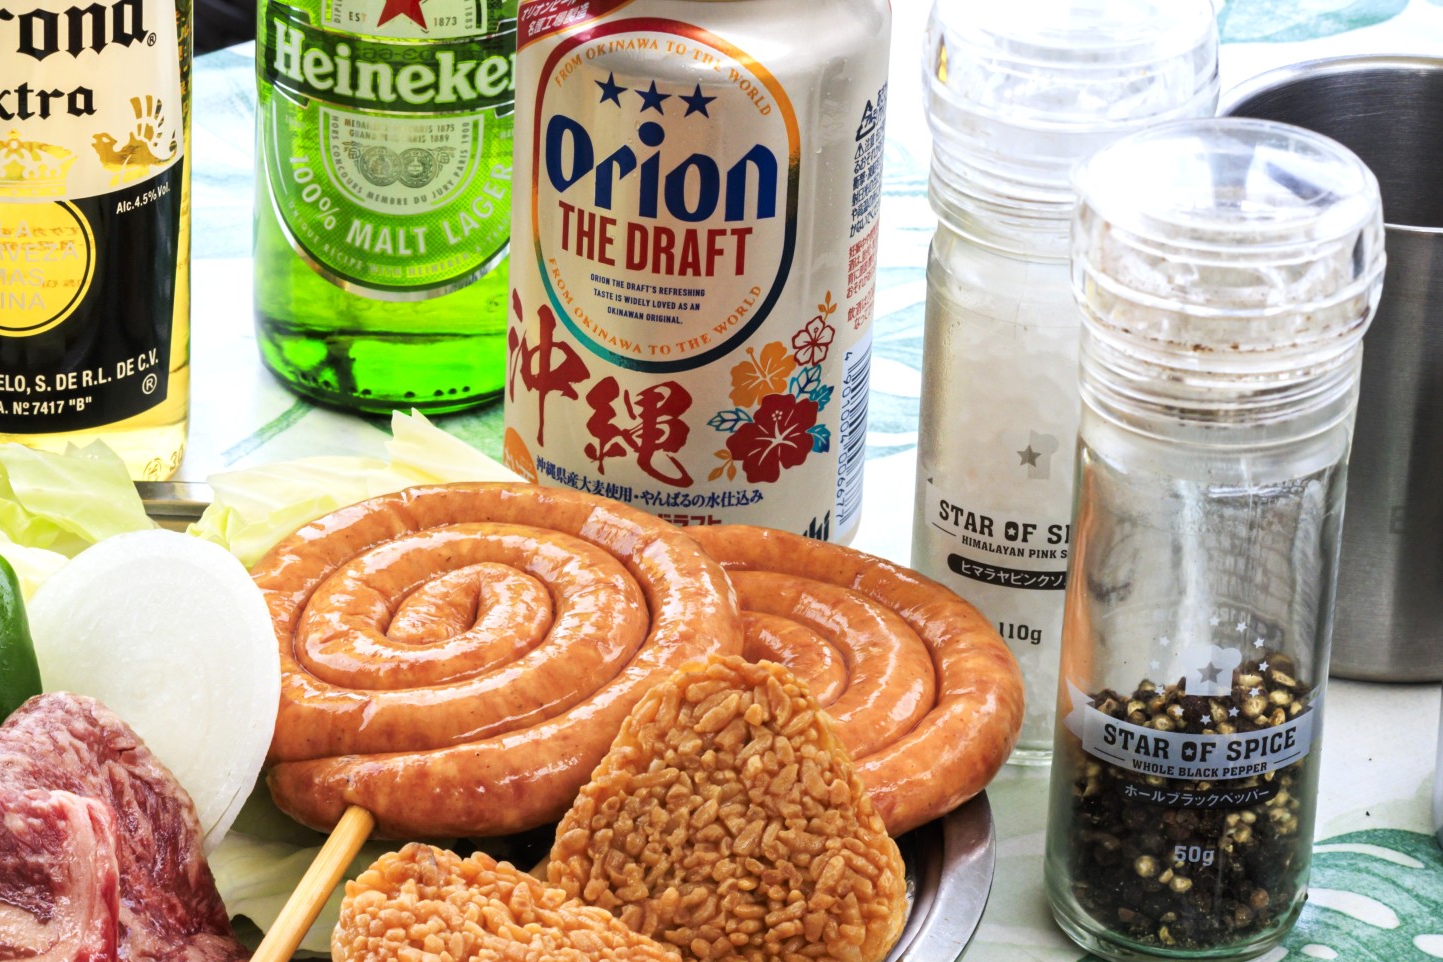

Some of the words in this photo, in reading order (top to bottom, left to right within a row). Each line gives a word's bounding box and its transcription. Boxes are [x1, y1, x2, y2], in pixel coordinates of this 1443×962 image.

[434, 16, 457, 27] 1873
[555, 56, 584, 88] FROM
[585, 37, 658, 60] OKINAWA
[667, 40, 687, 56] TO
[693, 47, 721, 72] THE
[728, 68, 772, 117] WORLD
[331, 115, 339, 140] HORS
[332, 145, 363, 194] CONCOURS
[453, 149, 469, 178] PARIS
[545, 114, 778, 222] Orion
[367, 190, 408, 206] MEMBRE
[414, 195, 427, 204] DU
[432, 179, 454, 199] JURY
[289, 154, 340, 231] 100%
[346, 218, 428, 256] MALT
[442, 162, 512, 246] LAGER
[558, 199, 617, 267] THE
[625, 221, 754, 277] DRAFT
[590, 273, 610, 286] ORION
[612, 278, 624, 289] THE
[626, 282, 657, 294] DRAFT'S
[659, 286, 706, 297] REFRESHING
[548, 257, 574, 305] FROM
[574, 306, 642, 354] OKINAWA
[648, 343, 672, 356] TO
[675, 332, 712, 353] THE
[713, 284, 762, 336] WORLD
[593, 287, 614, 301] TASTE
[615, 294, 622, 302] IS
[624, 295, 651, 307] WIDELY
[652, 301, 676, 310] LOVED
[677, 302, 688, 311] AS
[689, 303, 701, 311] AN
[607, 306, 644, 320] OKINAWAN
[645, 313, 683, 325] ORIGINAL.
[35, 373, 52, 392] S.
[56, 371, 77, 391] DE
[84, 365, 112, 387] R.L.
[116, 357, 134, 380] DE
[138, 348, 159, 372] C.V.
[508, 288, 694, 488] 沖縄
[32, 396, 64, 415] 7417
[69, 395, 92, 413] "B"
[939, 499, 994, 538] STAR
[1004, 520, 1037, 544] OF
[961, 534, 1025, 557] HIMALAYAN
[1028, 549, 1057, 559] PINK
[961, 560, 1067, 587] ヒマラヤピンクソ
[998, 622, 1043, 645] 110g
[1103, 722, 1169, 760] STAR
[1181, 741, 1217, 763] OF
[1226, 726, 1298, 762] SPICE
[1132, 758, 1175, 777] WHOLE
[1178, 766, 1219, 778] BLACK
[1222, 762, 1268, 777] PEPPER
[1124, 784, 1271, 807] ホールブラックペッパー
[1174, 844, 1216, 867] 50g
